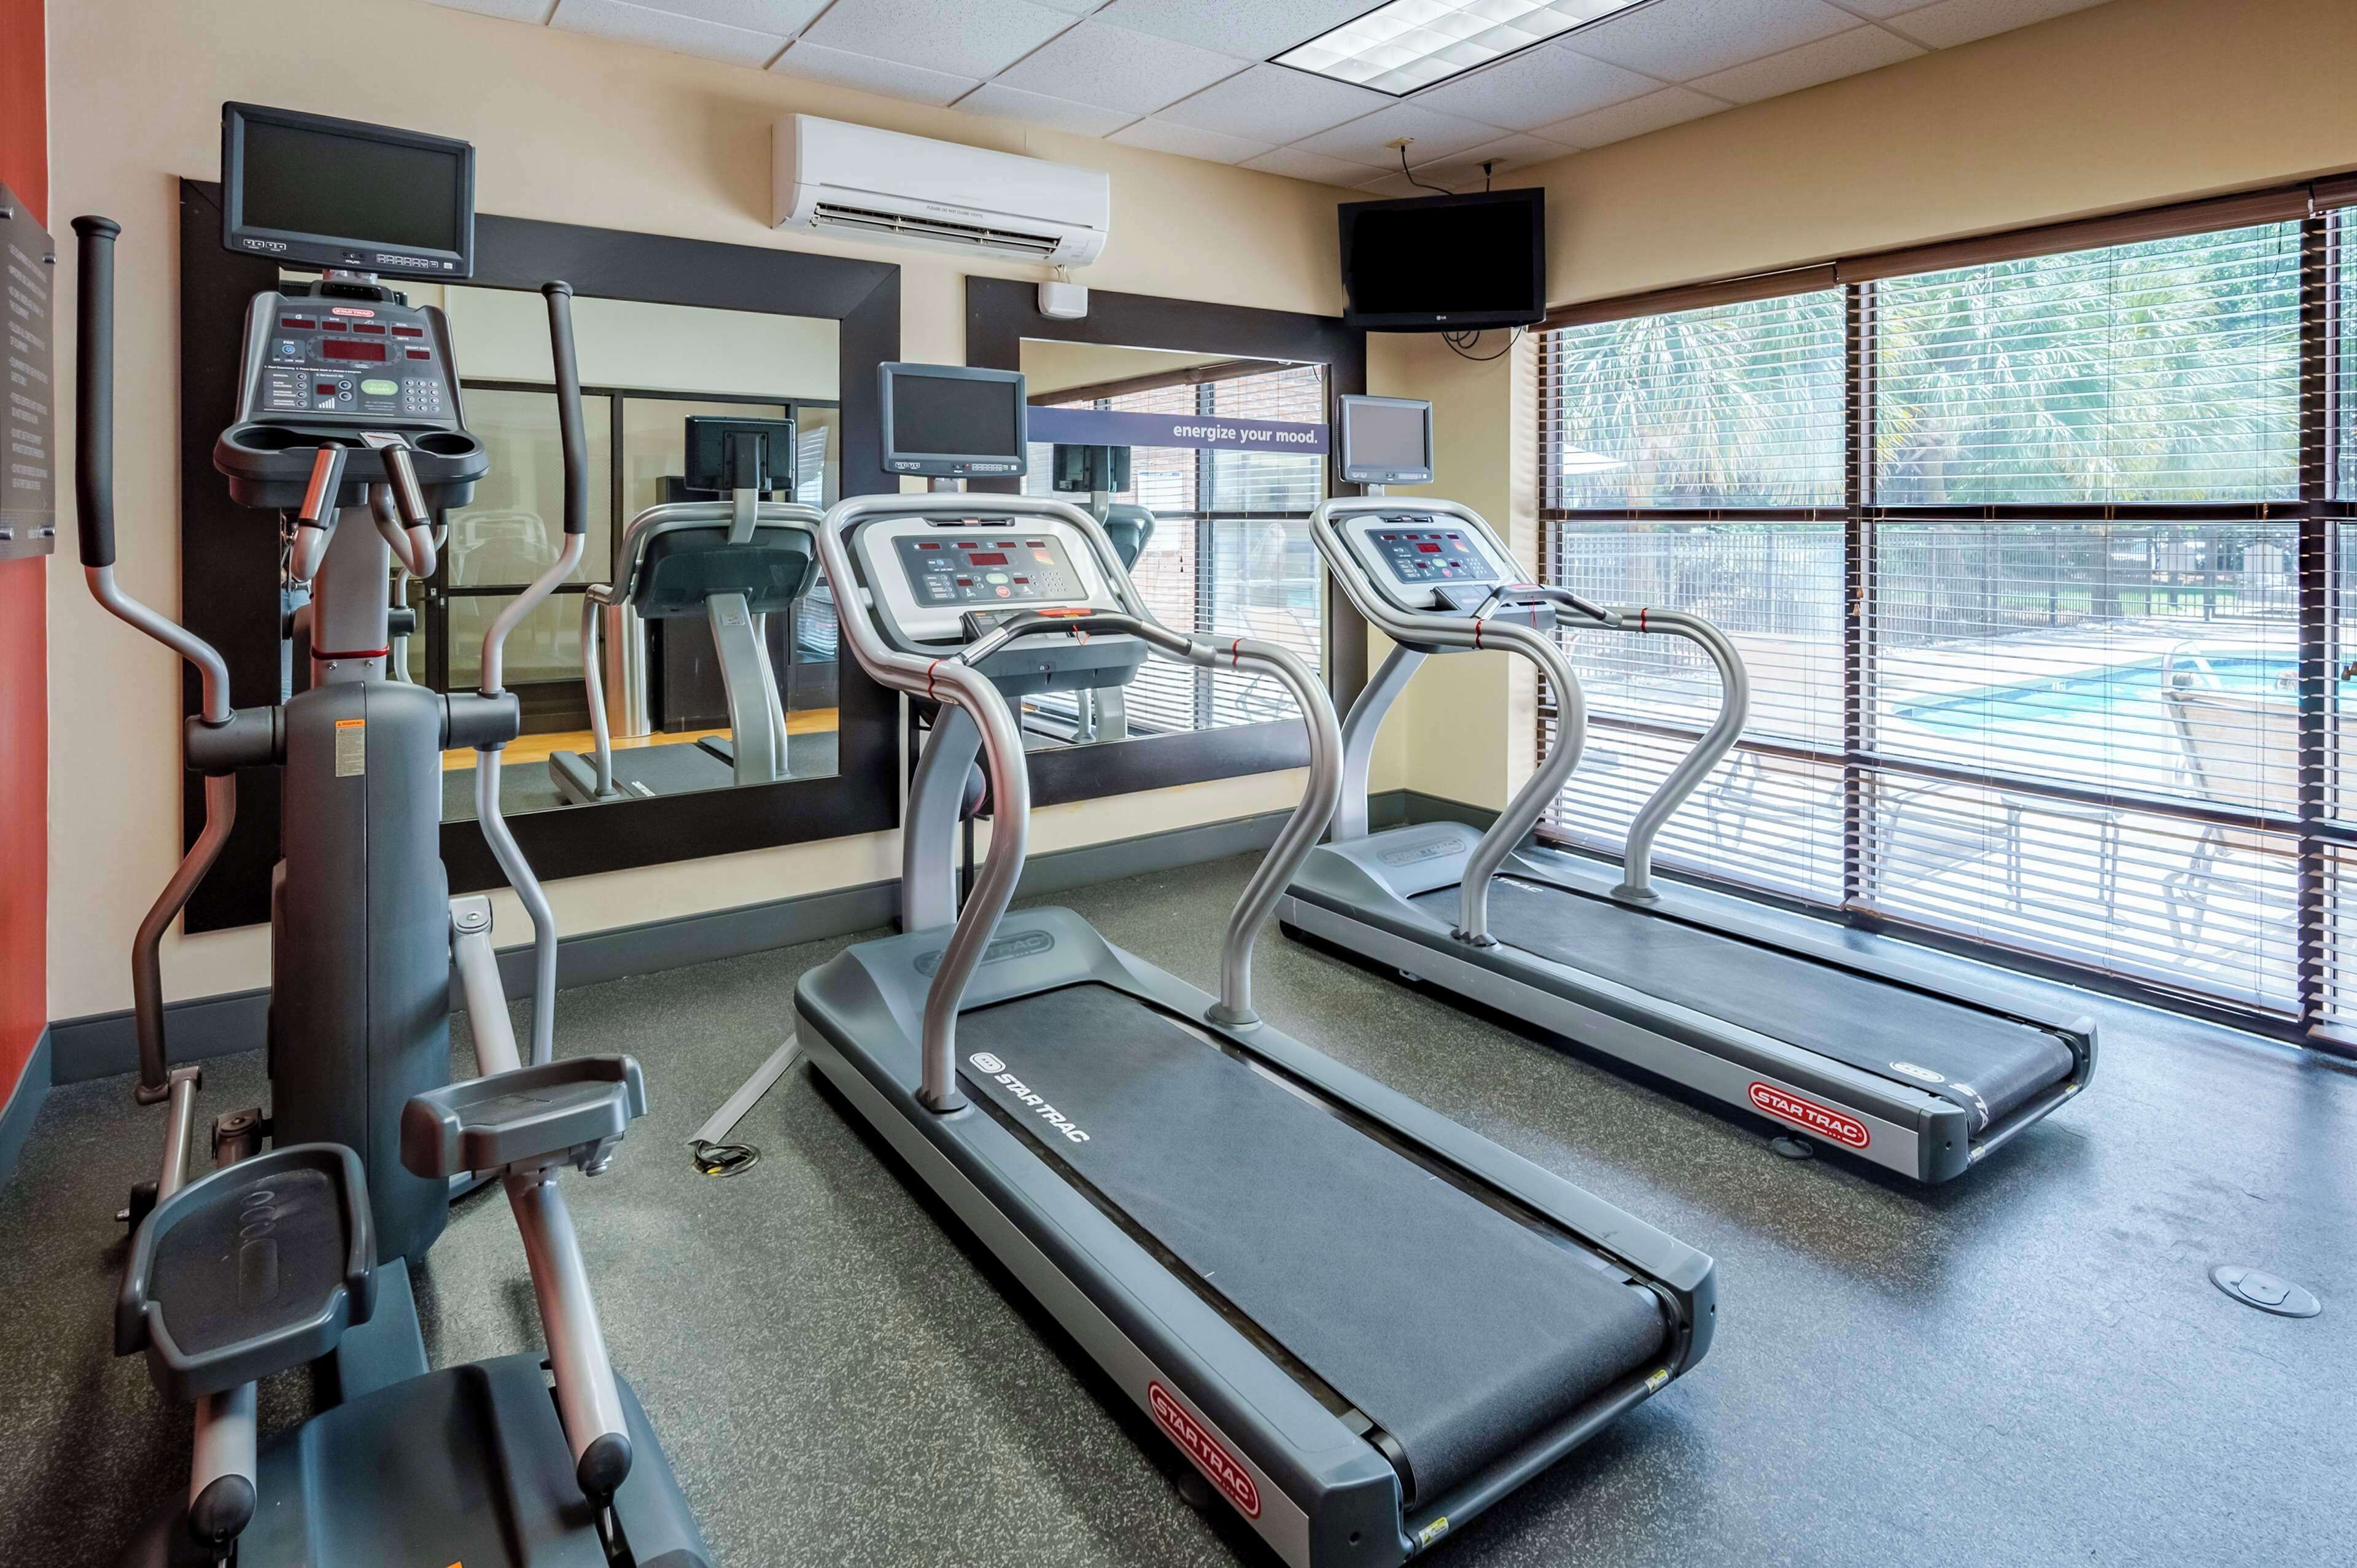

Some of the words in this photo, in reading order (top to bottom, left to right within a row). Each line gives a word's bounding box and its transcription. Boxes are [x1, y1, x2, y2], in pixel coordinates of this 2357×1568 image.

[1173, 424, 1237, 441] energize
[1240, 429, 1273, 443] your
[1276, 430, 1318, 444] mood.
[1498, 877, 1544, 893] TRAC
[994, 1073, 1044, 1106] STAR
[1035, 1104, 1090, 1143] TRAC
[1755, 1091, 1803, 1117] STAR
[1806, 1109, 1858, 1138] TRAC
[1155, 1397, 1198, 1448] STAR
[1200, 1440, 1249, 1499] TRAC
